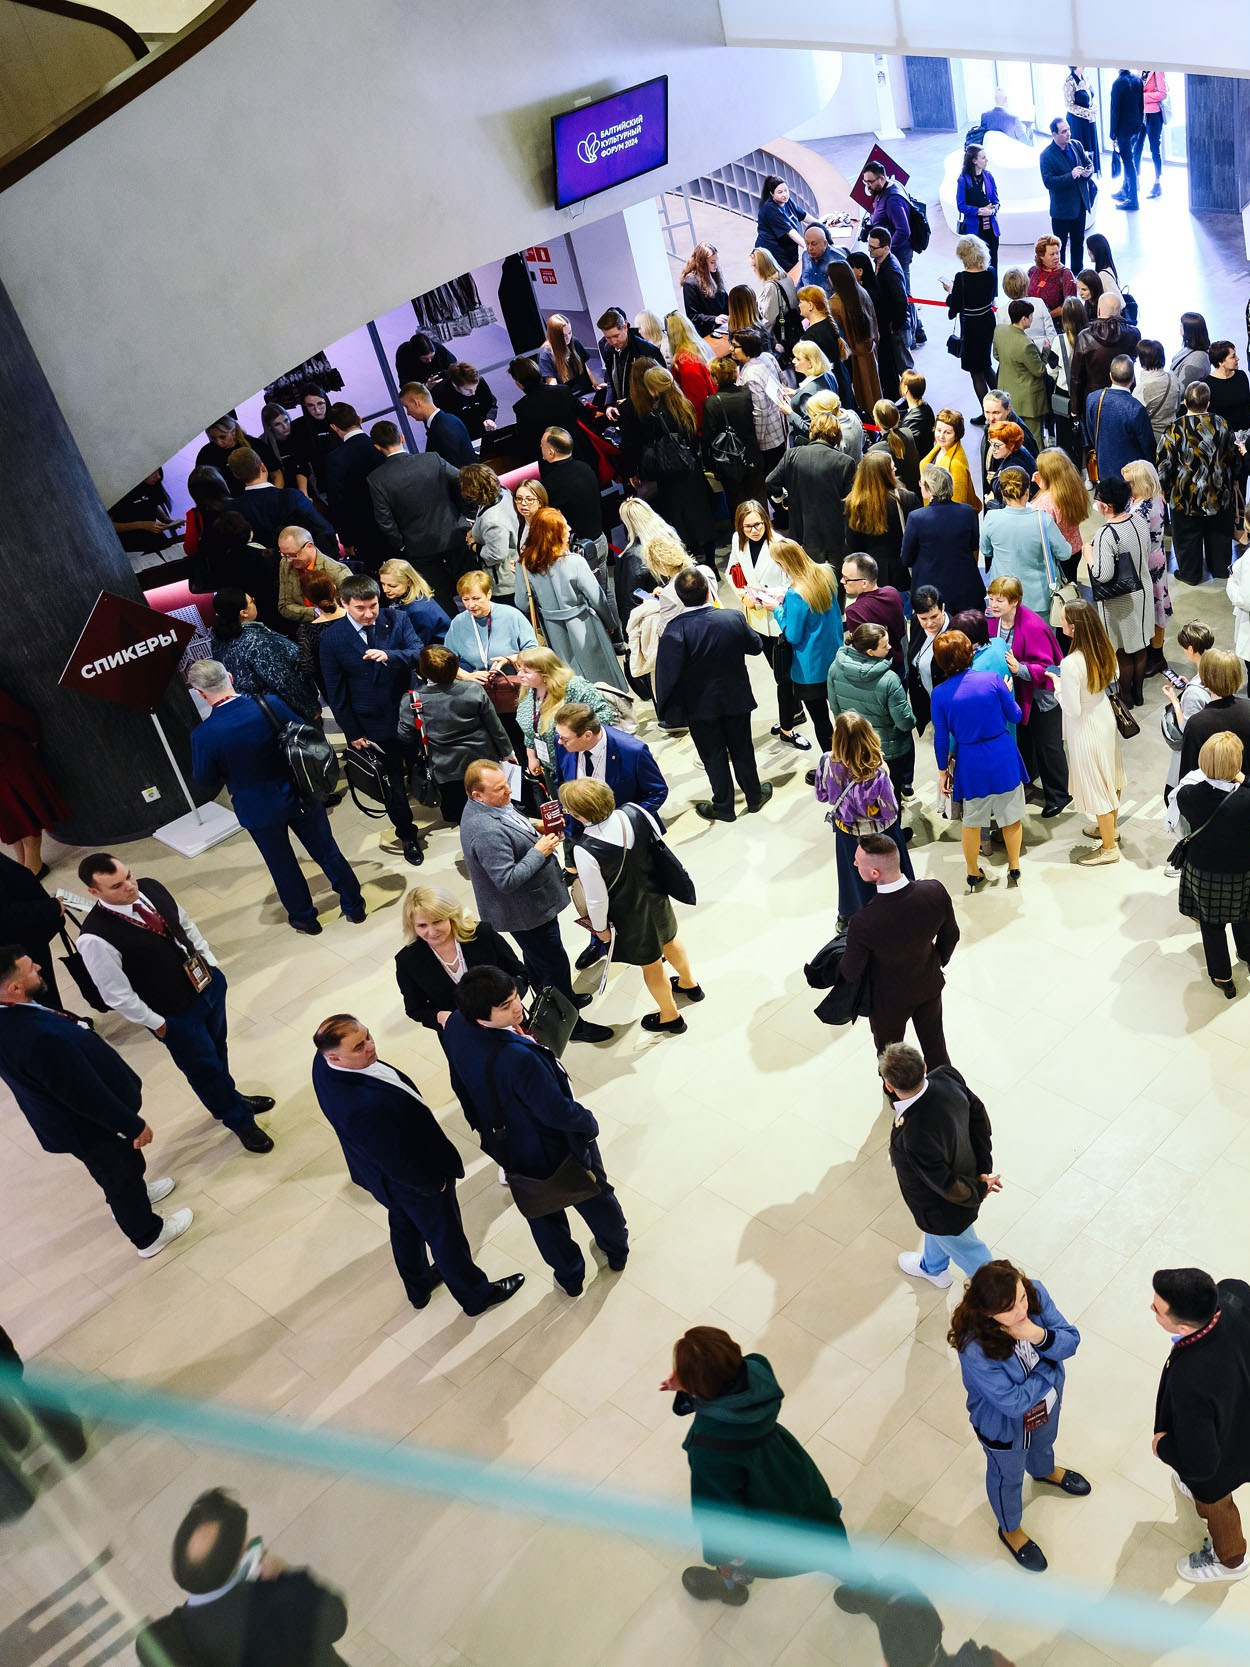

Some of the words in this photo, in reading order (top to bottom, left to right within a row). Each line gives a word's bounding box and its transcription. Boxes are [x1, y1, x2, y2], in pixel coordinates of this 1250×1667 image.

[600, 114, 643, 138] БАЛТИЙСКИЙ
[600, 125, 642, 148] КУЛЬТУРНЫЙ
[600, 142, 625, 157] ФОРУМ
[624, 137, 639, 149] 2024
[81, 629, 178, 678] СПИКЕРЫ
